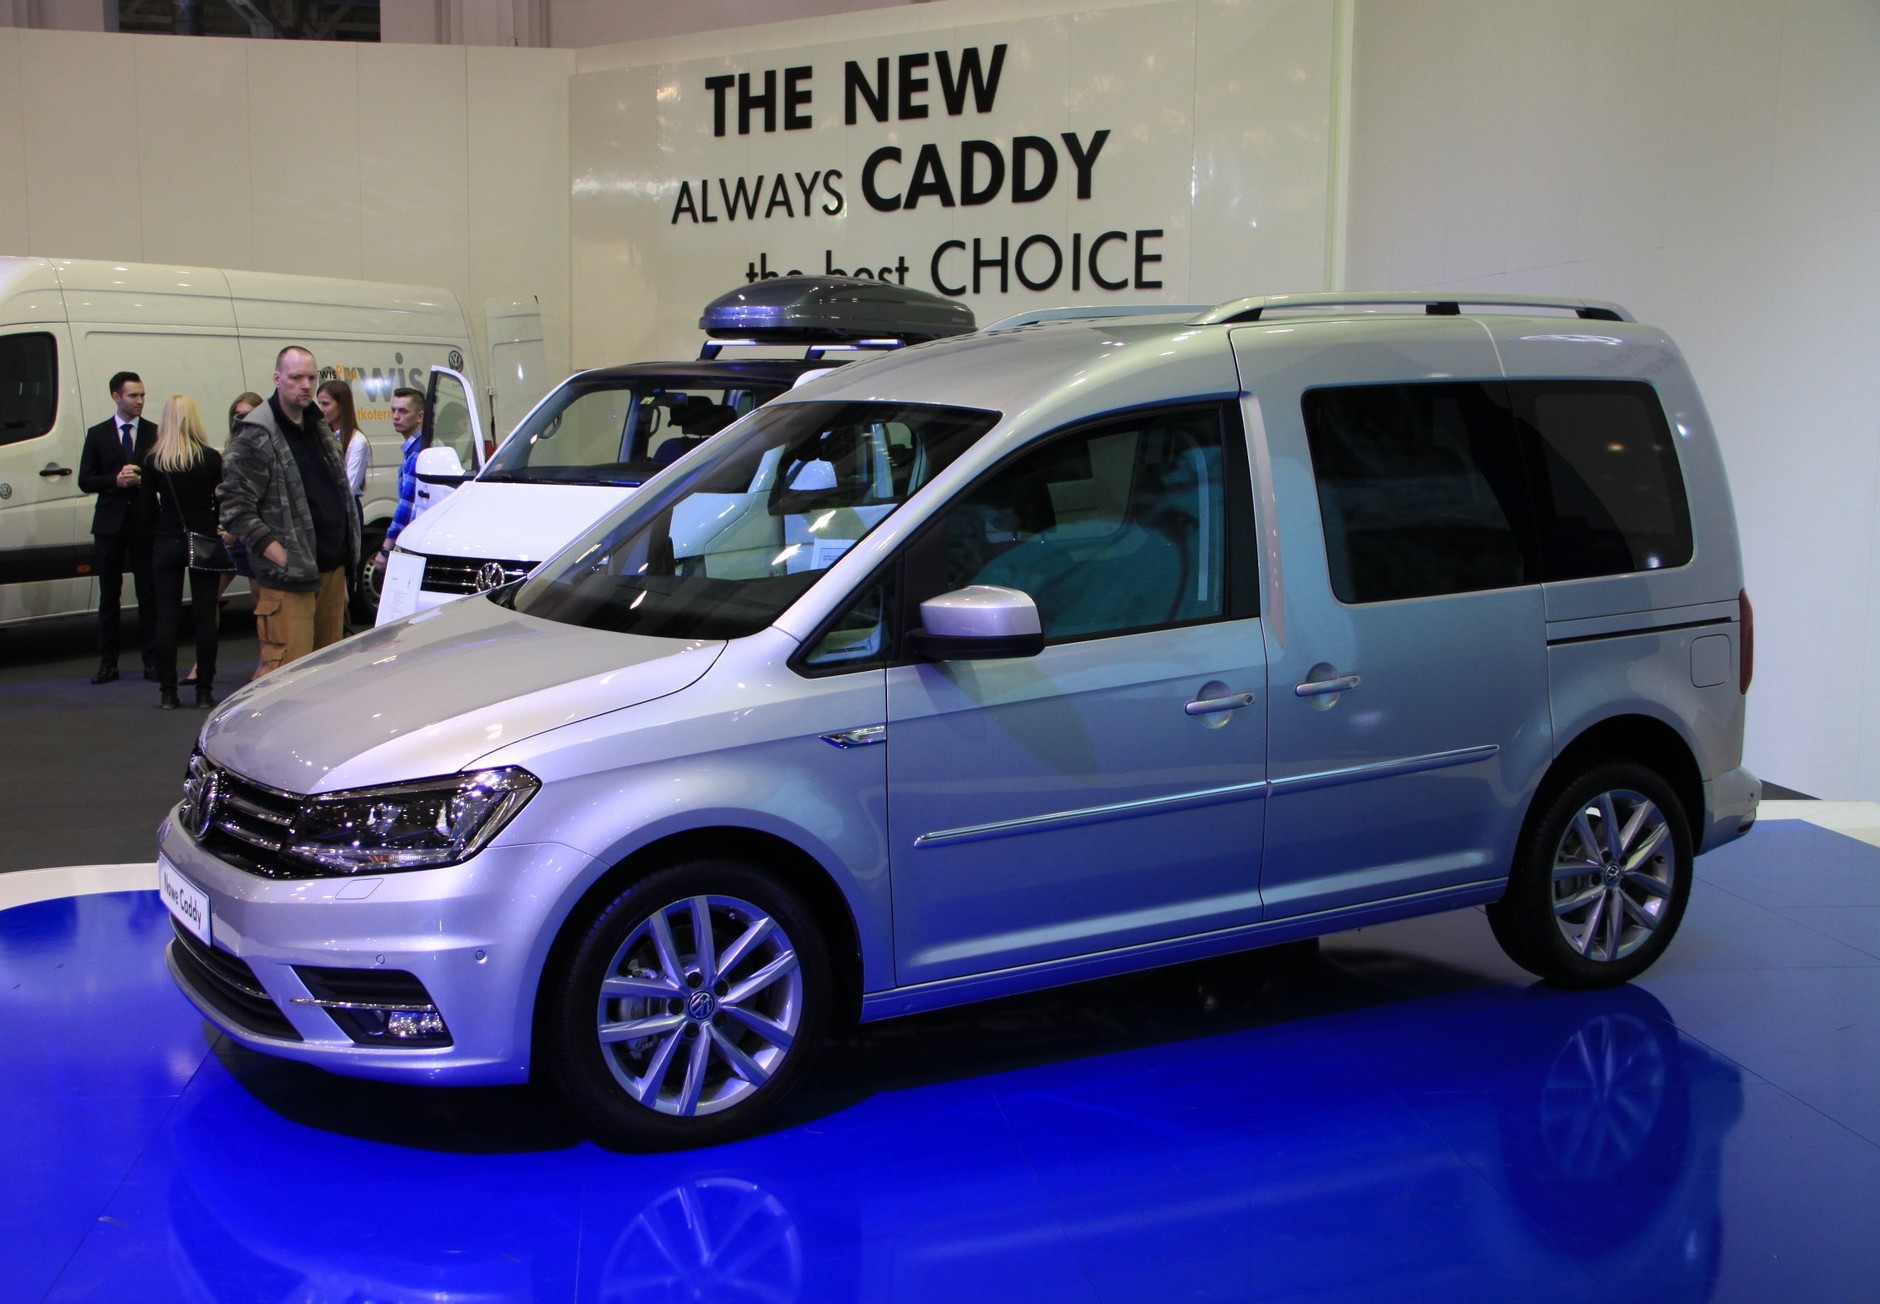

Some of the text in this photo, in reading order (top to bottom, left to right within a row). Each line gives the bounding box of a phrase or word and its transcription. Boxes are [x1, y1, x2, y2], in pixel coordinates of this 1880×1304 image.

[705, 44, 1007, 137] THE NEW
[672, 130, 1110, 224] ALWAYS CADDY
[746, 253, 804, 283] th
[931, 230, 1164, 296] CHOICE
[179, 888, 202, 930] Caddy
